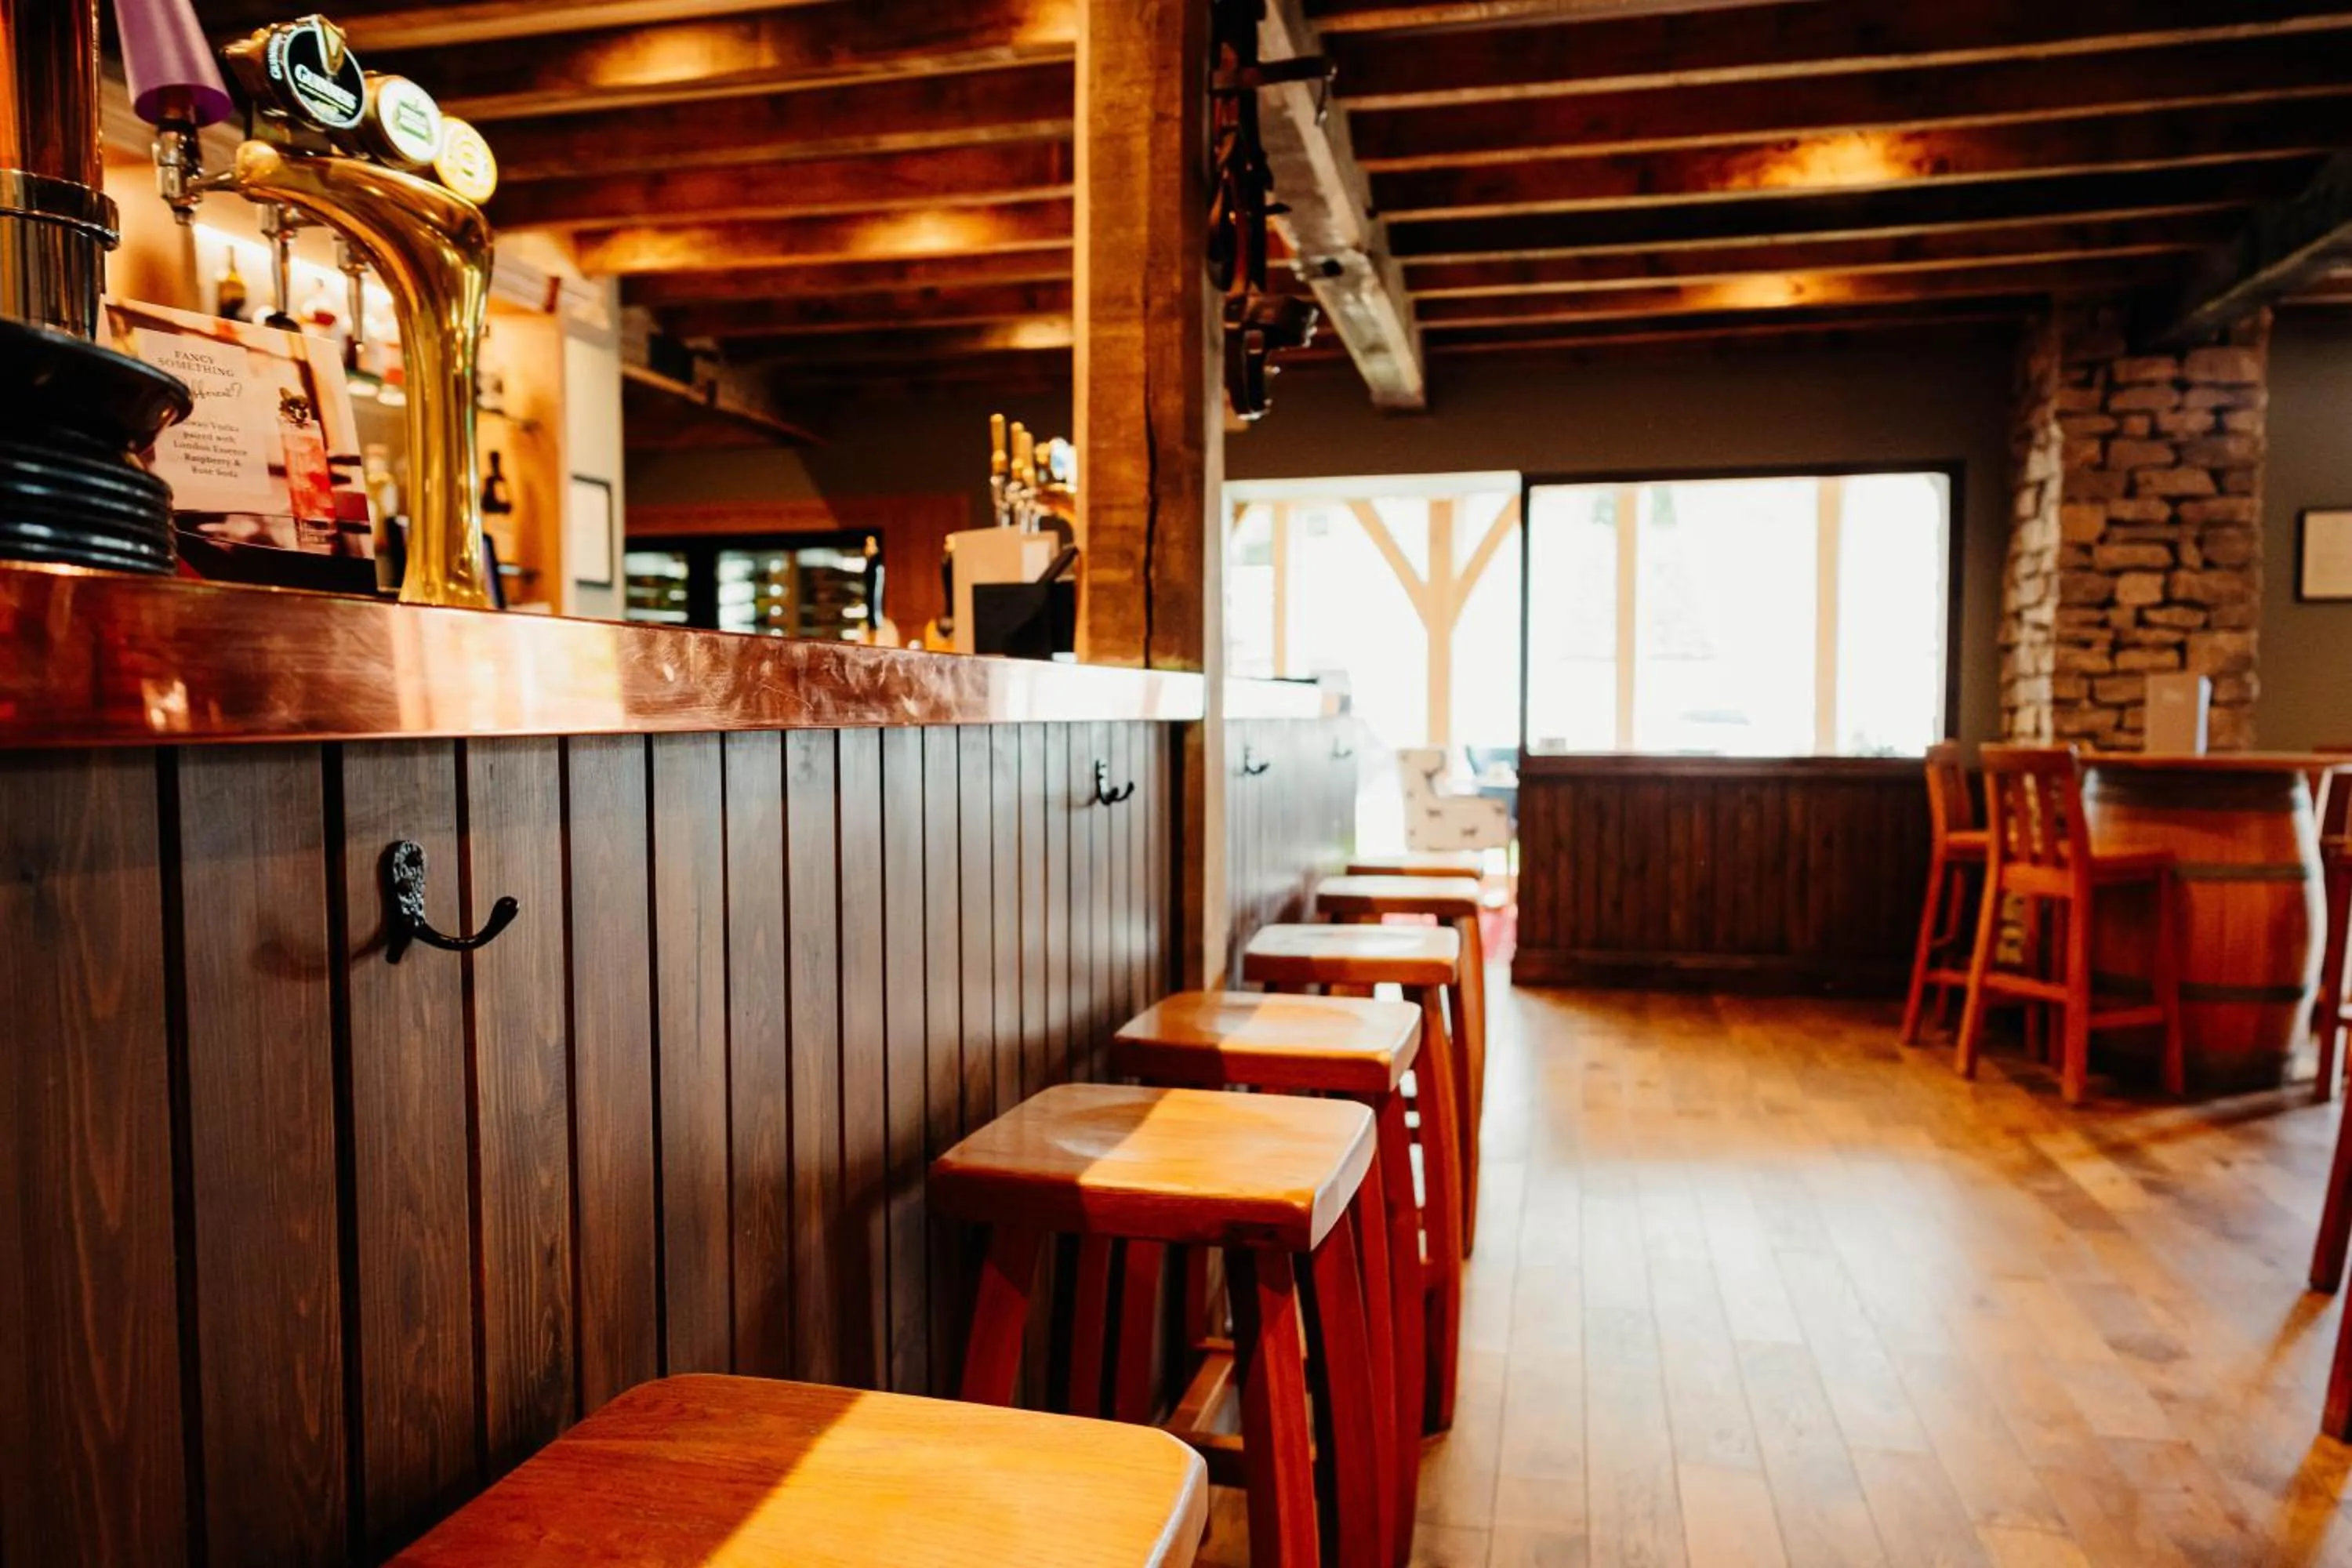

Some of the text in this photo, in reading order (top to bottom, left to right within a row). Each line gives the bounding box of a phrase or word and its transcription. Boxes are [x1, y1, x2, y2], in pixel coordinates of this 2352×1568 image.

[174, 350, 214, 364] FANCY
[157, 358, 234, 377] SOMETHING
[172, 440, 211, 452] London
[183, 453, 231, 468] Raspberry
